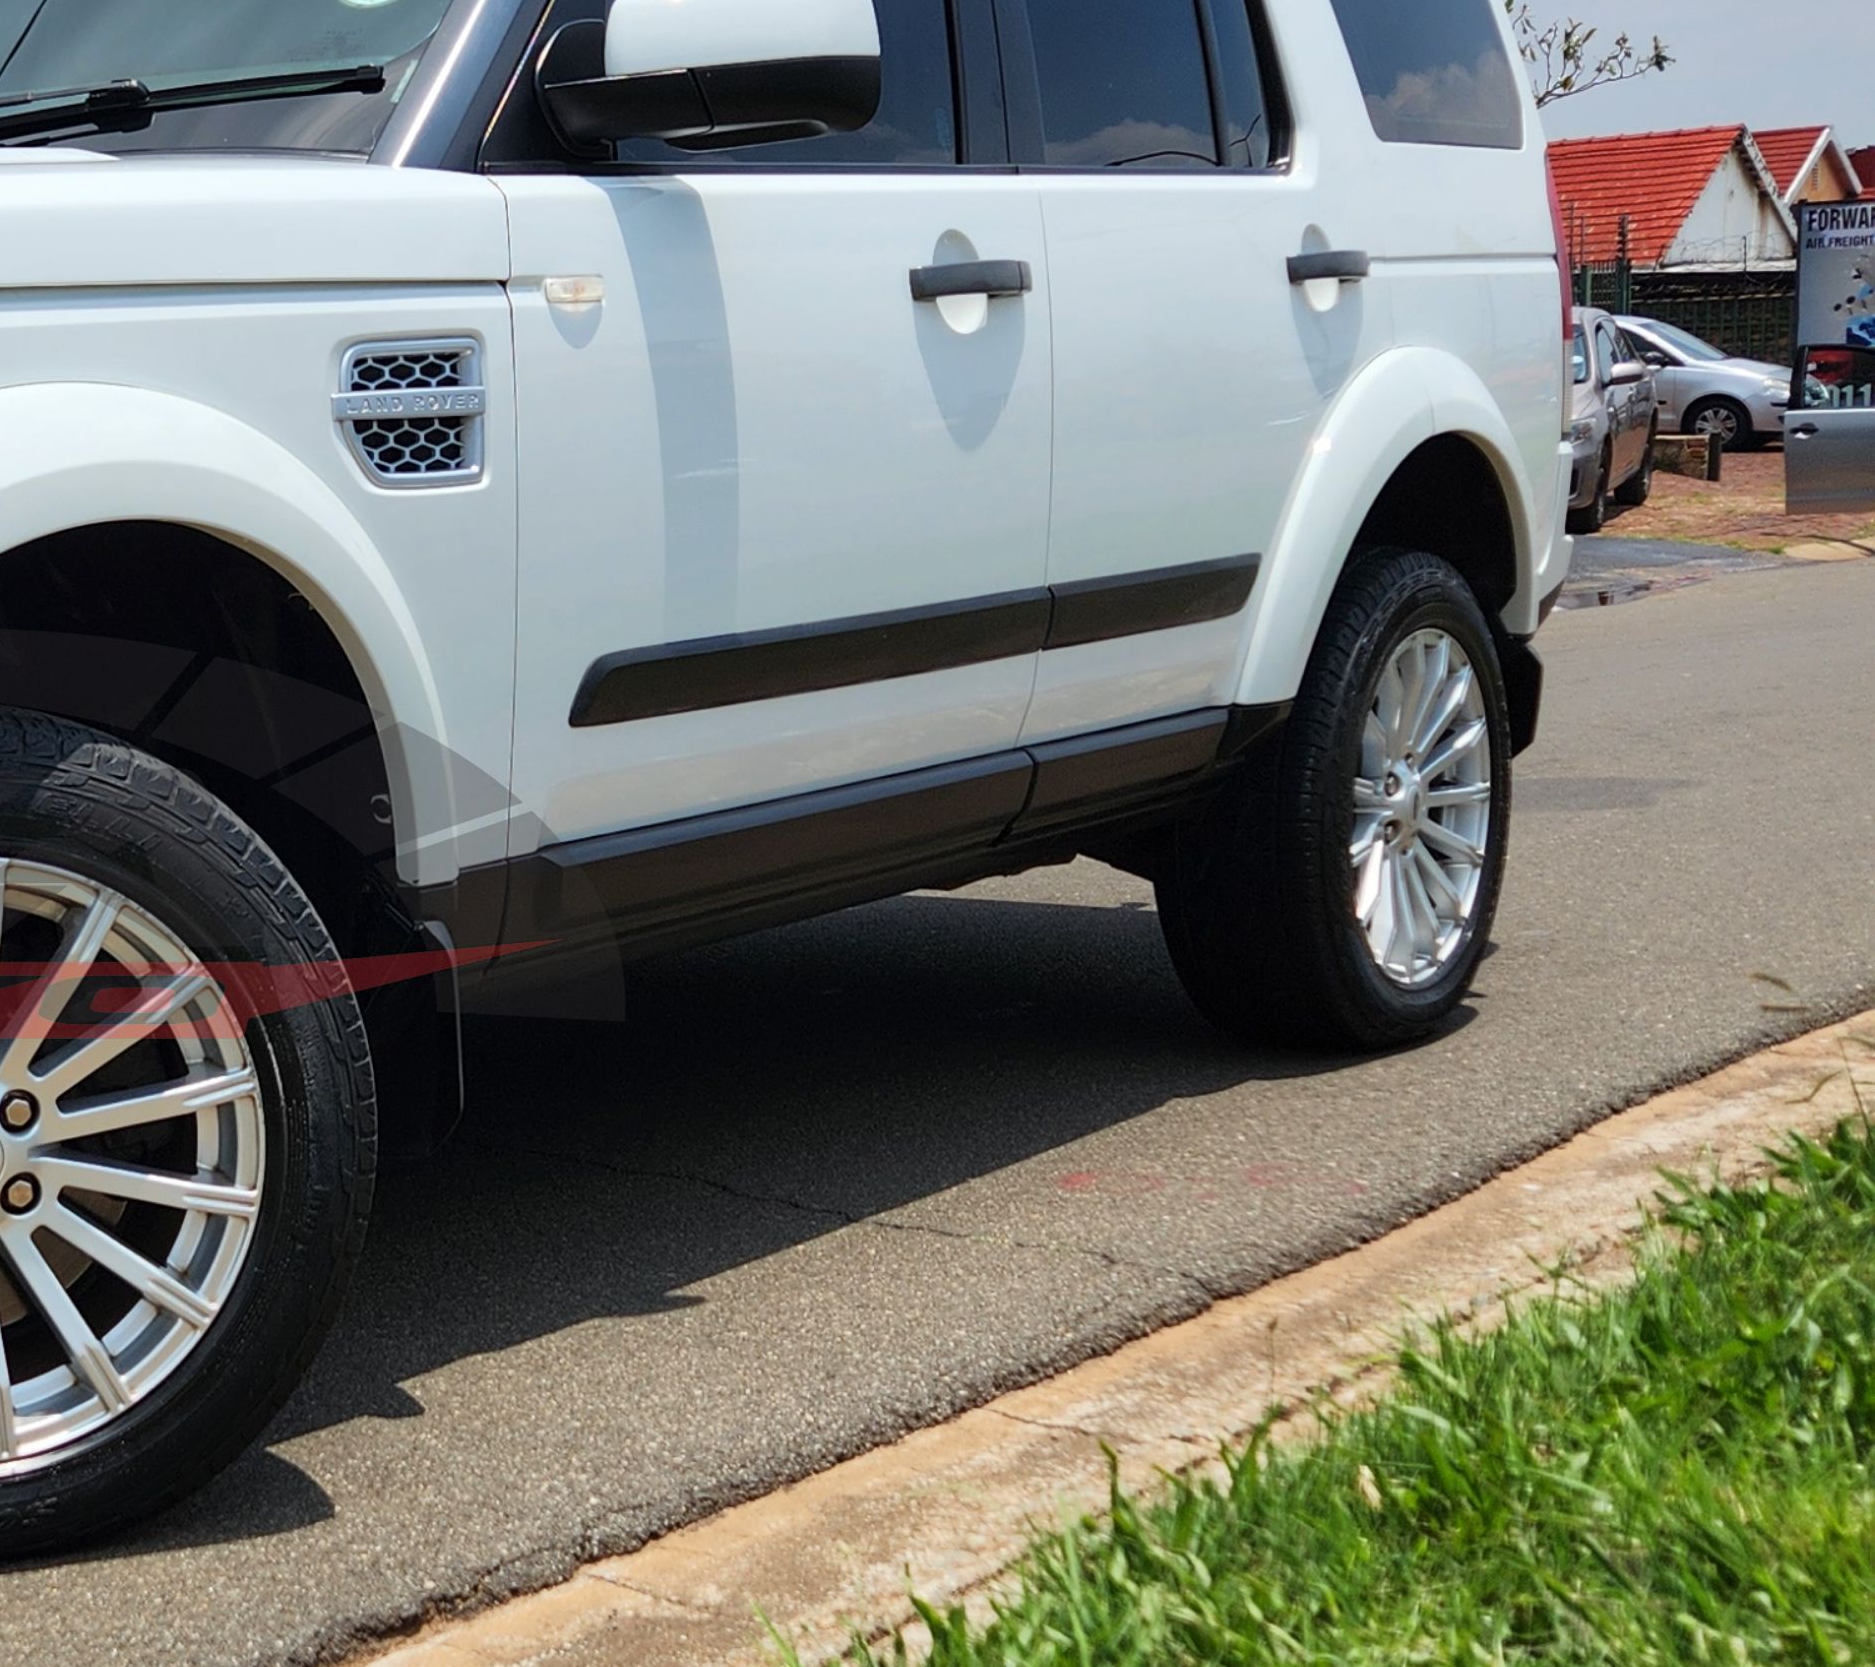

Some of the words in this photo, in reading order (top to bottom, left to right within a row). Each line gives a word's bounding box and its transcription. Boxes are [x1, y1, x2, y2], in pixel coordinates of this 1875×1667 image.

[1806, 237, 1825, 249] AIR
[345, 396, 404, 415] LAND
[413, 392, 480, 412] ROVER
